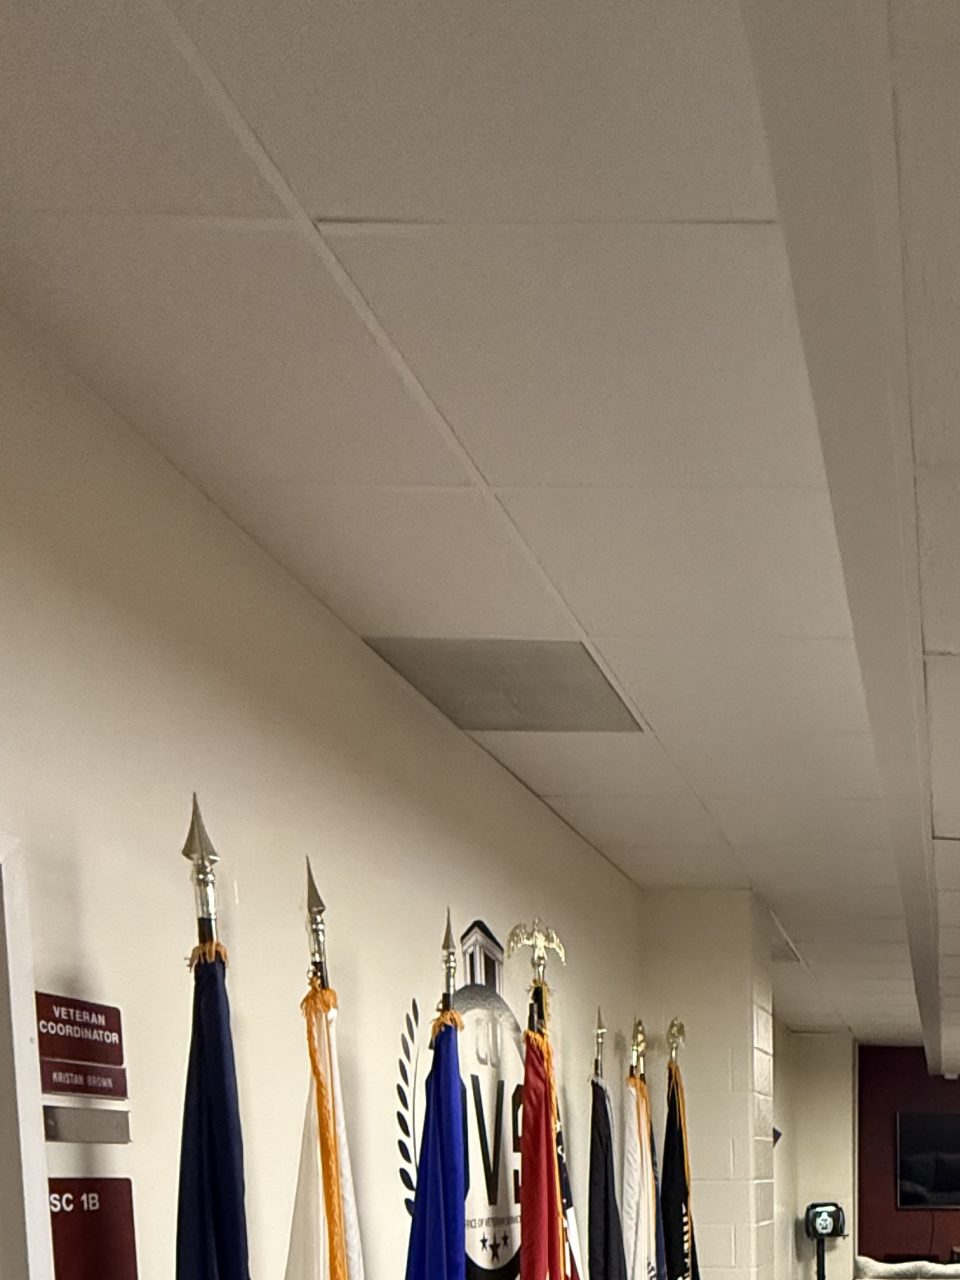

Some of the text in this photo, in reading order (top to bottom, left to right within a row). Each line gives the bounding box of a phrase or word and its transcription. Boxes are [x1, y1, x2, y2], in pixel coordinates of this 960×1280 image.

[52, 1005, 106, 1027] VETERAN
[39, 1020, 120, 1045] COORDINATOR
[50, 1193, 100, 1213] SC 1B
